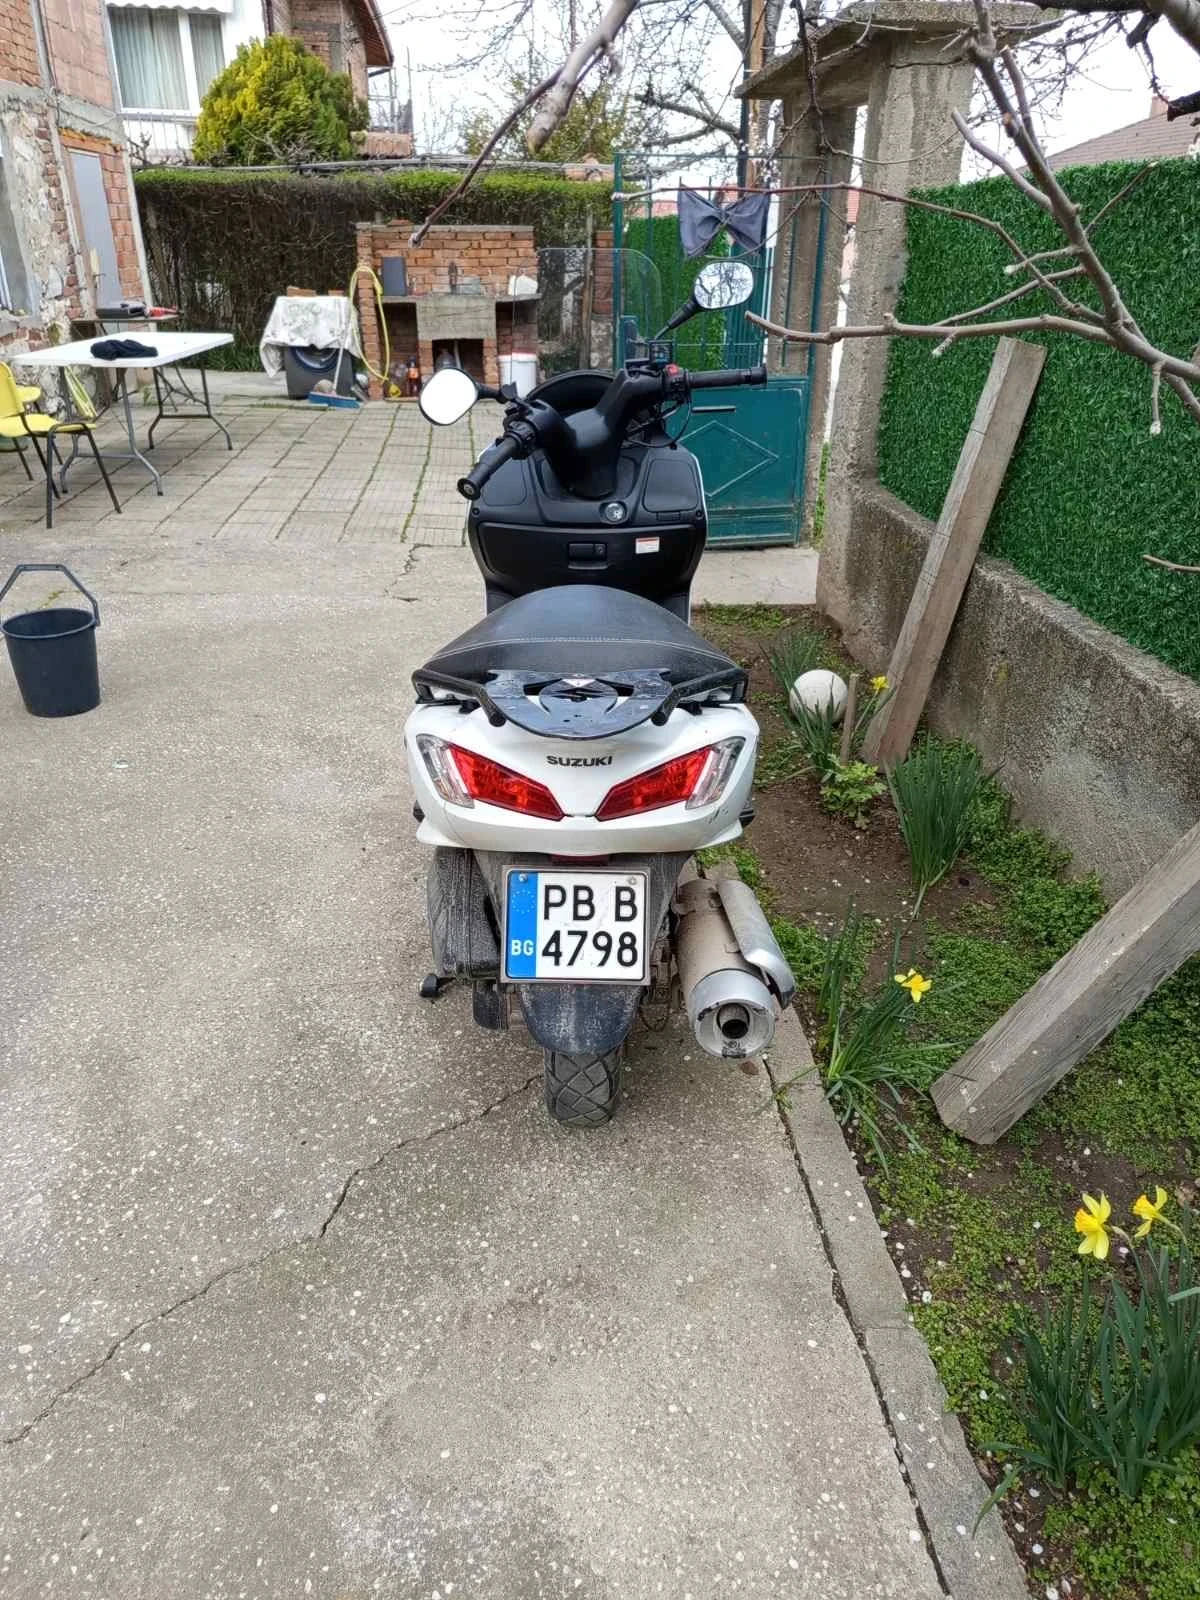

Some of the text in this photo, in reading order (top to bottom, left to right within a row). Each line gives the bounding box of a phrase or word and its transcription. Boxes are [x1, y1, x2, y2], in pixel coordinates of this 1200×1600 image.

[546, 755, 613, 767] SUZUKI
[543, 884, 638, 922] PB B
[511, 940, 534, 956] BG
[541, 930, 638, 967] 4798
